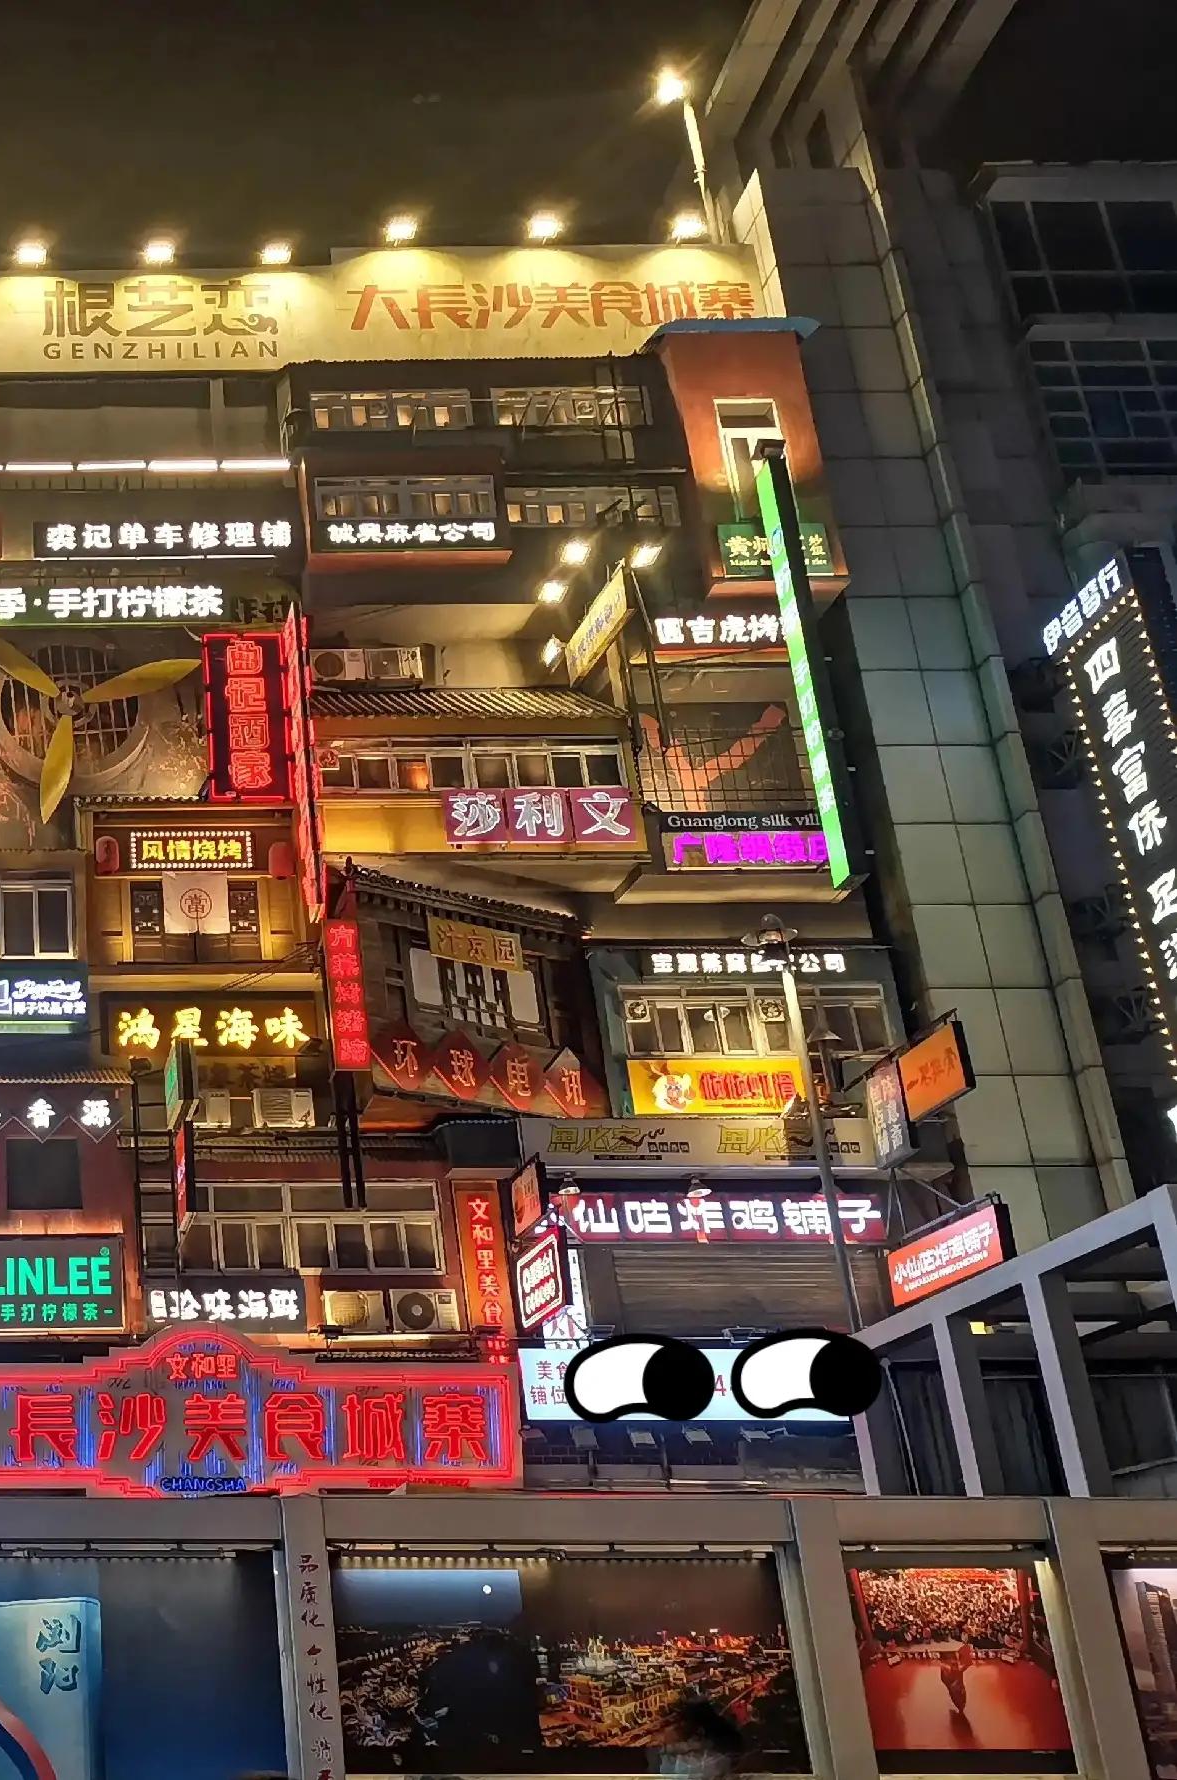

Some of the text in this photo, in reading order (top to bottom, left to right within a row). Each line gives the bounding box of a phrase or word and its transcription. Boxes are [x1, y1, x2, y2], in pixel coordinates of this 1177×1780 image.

[346, 280, 756, 331] 大長沙美食城寨
[43, 341, 279, 360] GENZHILIAN
[451, 792, 631, 837] 莎利文
[667, 813, 821, 830] Guanglong silk vill
[141, 839, 243, 861] 风情烧烤
[392, 1039, 587, 1107] 环球电讯
[166, 1353, 237, 1379] 文和里
[161, 1477, 247, 1491] CHANGSHA
